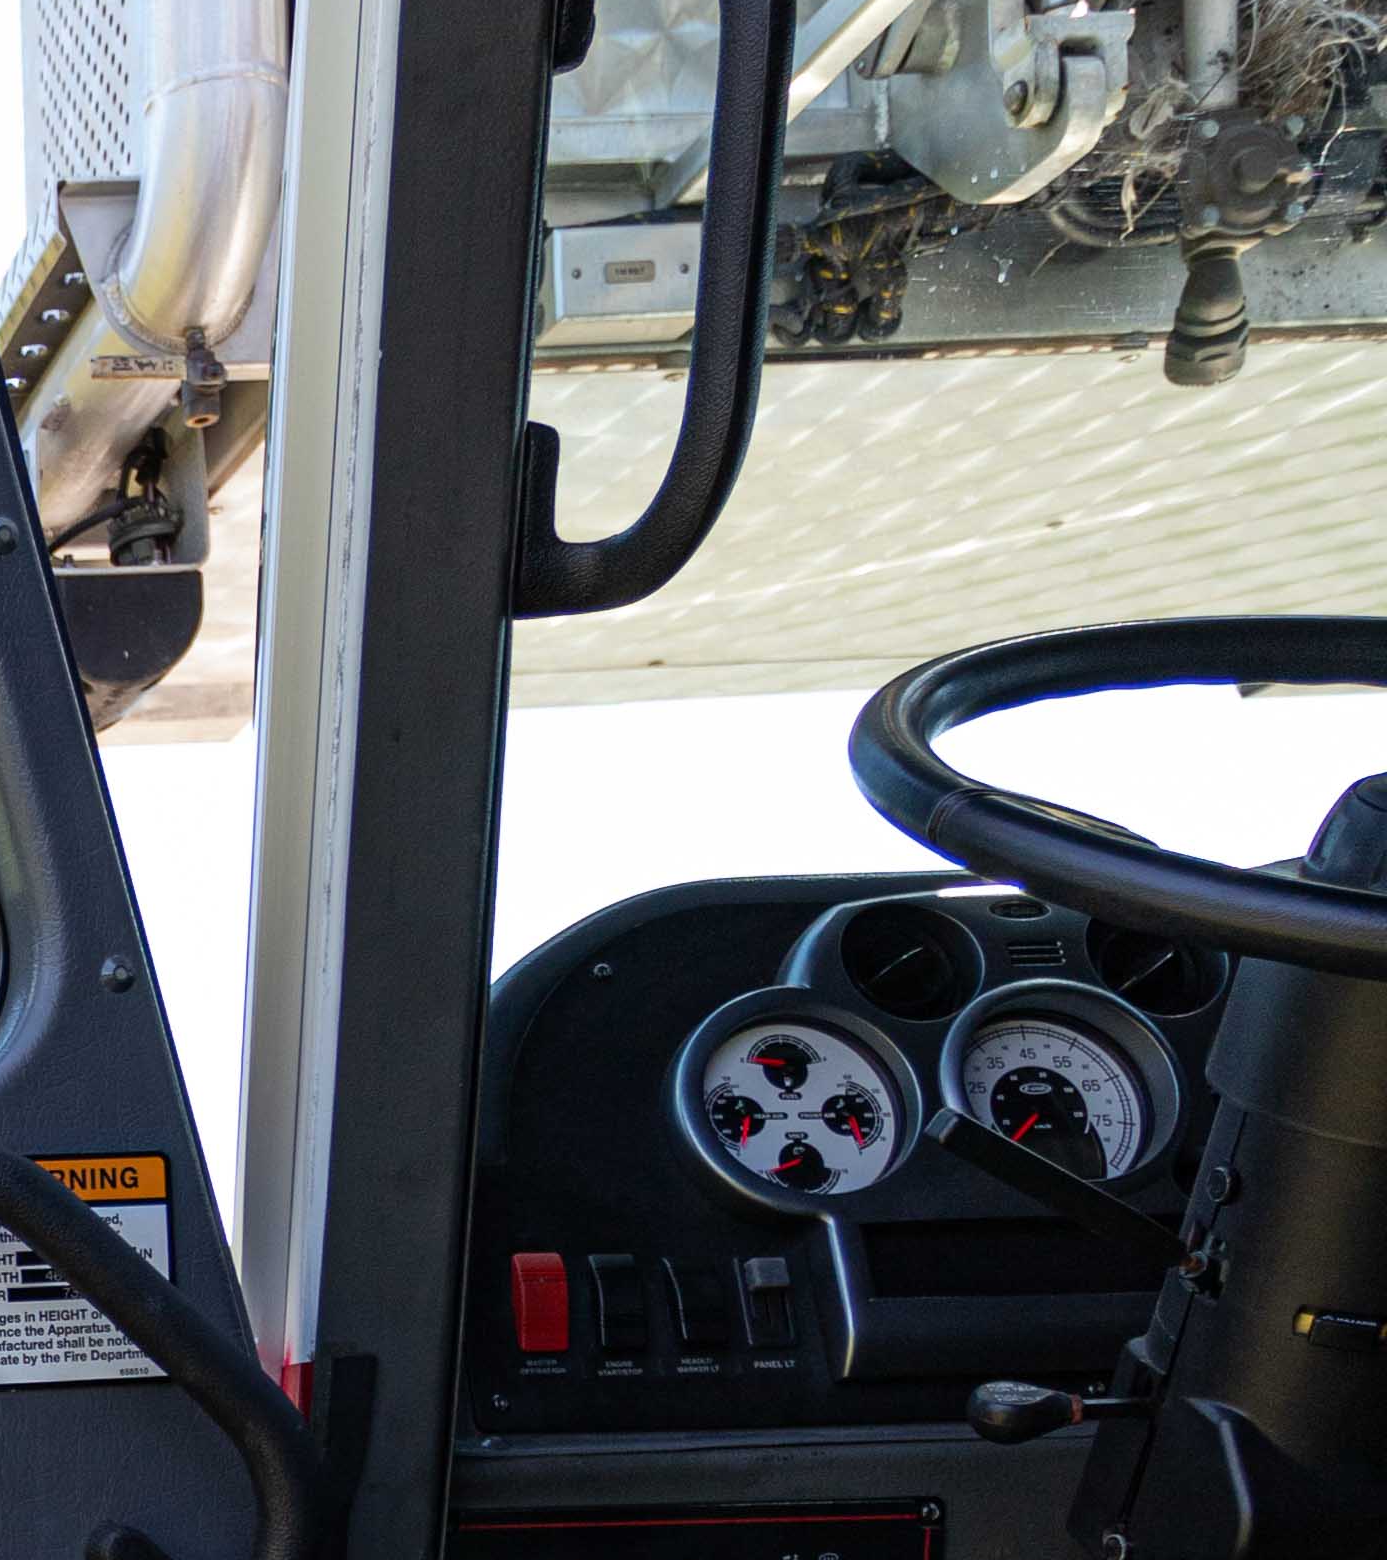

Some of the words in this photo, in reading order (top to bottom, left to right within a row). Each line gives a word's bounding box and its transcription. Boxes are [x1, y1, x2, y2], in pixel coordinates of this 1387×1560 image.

[1019, 1048, 1037, 1060] 45
[986, 1056, 1005, 1070] 35
[1052, 1056, 1072, 1069] 55
[968, 1081, 986, 1095] 25
[1081, 1079, 1101, 1093] 65
[1093, 1114, 1113, 1128] 75
[24, 1311, 36, 1323] in
[38, 1308, 89, 1322] HEIGHT
[24, 1324, 45, 1337] the
[47, 1322, 112, 1338] Apparatus
[56, 1336, 86, 1349] shall
[87, 1336, 105, 1348] be
[22, 1353, 38, 1366] by
[40, 1352, 61, 1364] the
[63, 1350, 88, 1363] Fire
